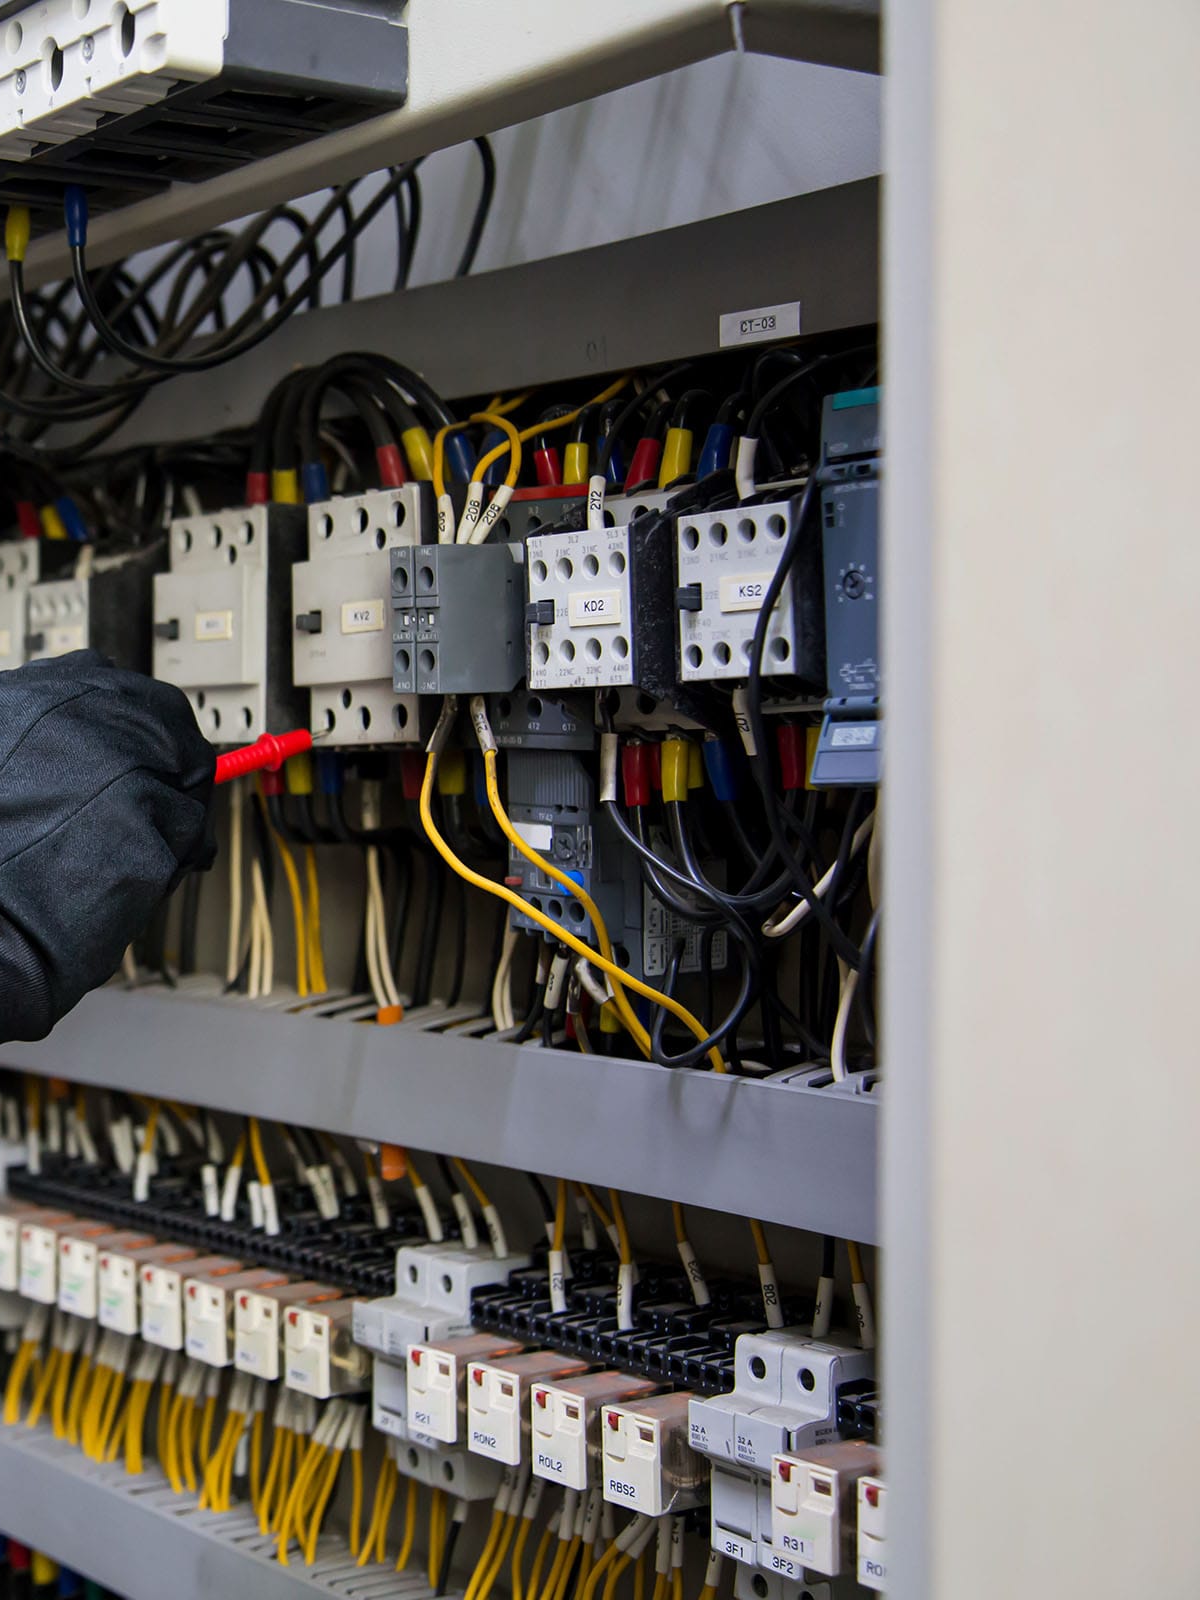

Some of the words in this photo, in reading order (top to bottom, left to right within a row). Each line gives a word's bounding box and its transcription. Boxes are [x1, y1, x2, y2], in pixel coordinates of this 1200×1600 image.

[740, 315, 776, 334] CT-03
[590, 490, 601, 510] 2Y2
[466, 500, 480, 523] 206
[739, 585, 761, 597] KS2
[584, 600, 604, 612] KD2
[354, 610, 370, 621] KV2
[763, 1283, 777, 1305] 208
[691, 1424, 700, 1433] 32
[474, 1432, 496, 1448] RON2
[738, 1436, 746, 1444] 32
[539, 1455, 562, 1472] ROL2
[610, 1480, 635, 1497] RBS2
[725, 1541, 744, 1558] 3F1
[783, 1536, 804, 1552] R31
[772, 1556, 794, 1575] 3F2
[866, 1561, 886, 1577] RO
